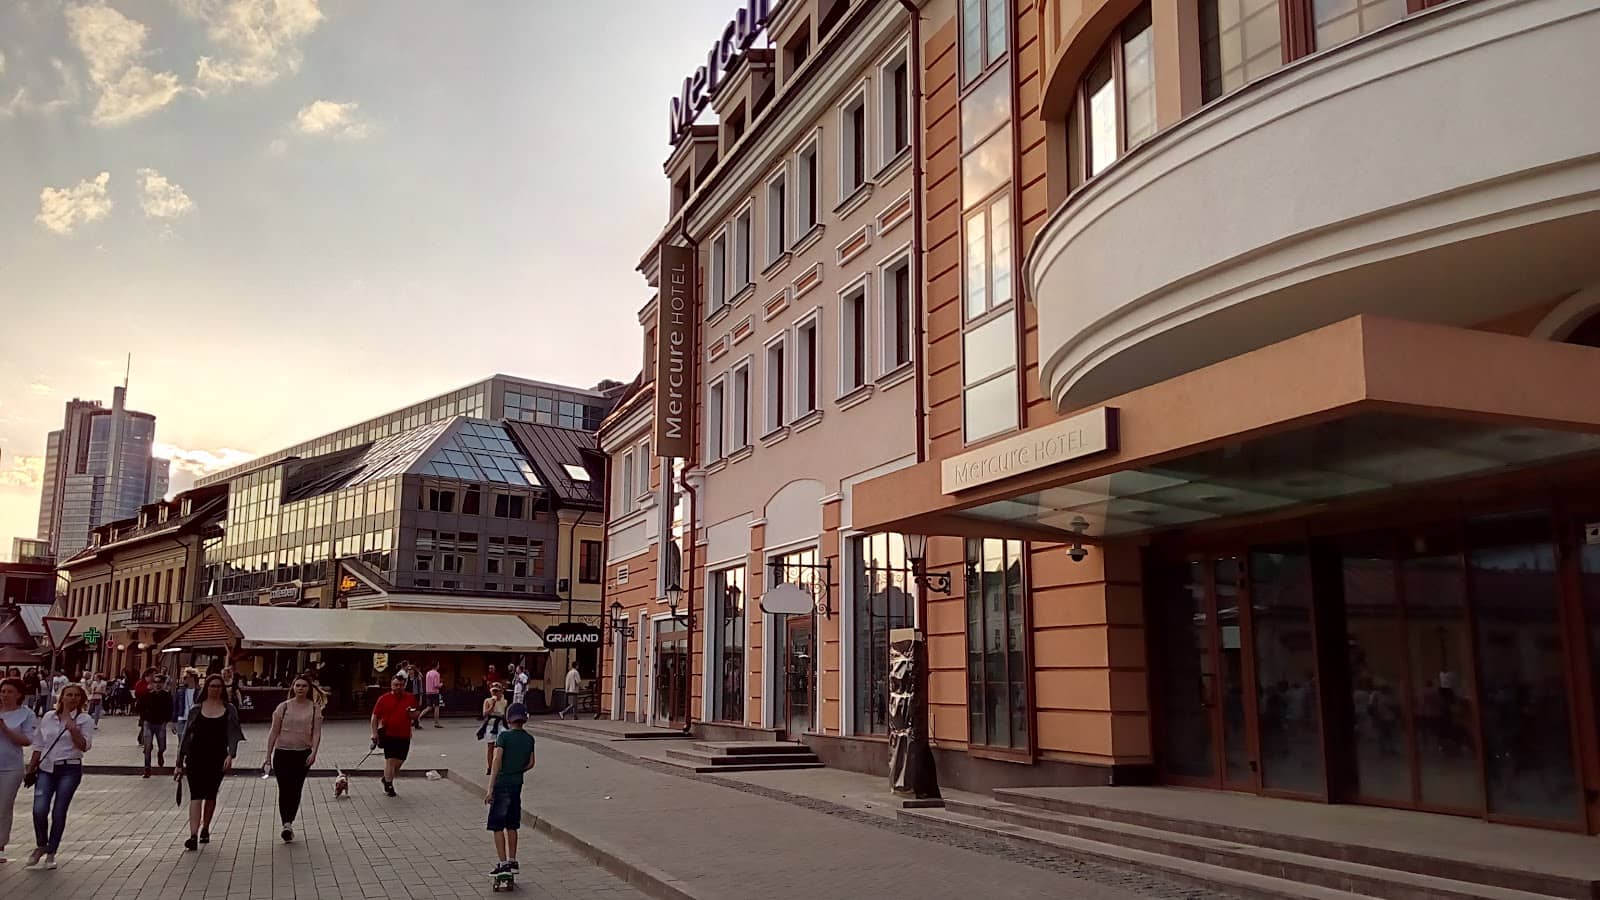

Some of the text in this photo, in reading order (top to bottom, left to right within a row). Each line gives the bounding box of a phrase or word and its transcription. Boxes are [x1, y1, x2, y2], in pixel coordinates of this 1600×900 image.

[665, 263, 685, 439] Mercure HOTEL
[955, 429, 1089, 487] Mercure HOTEL
